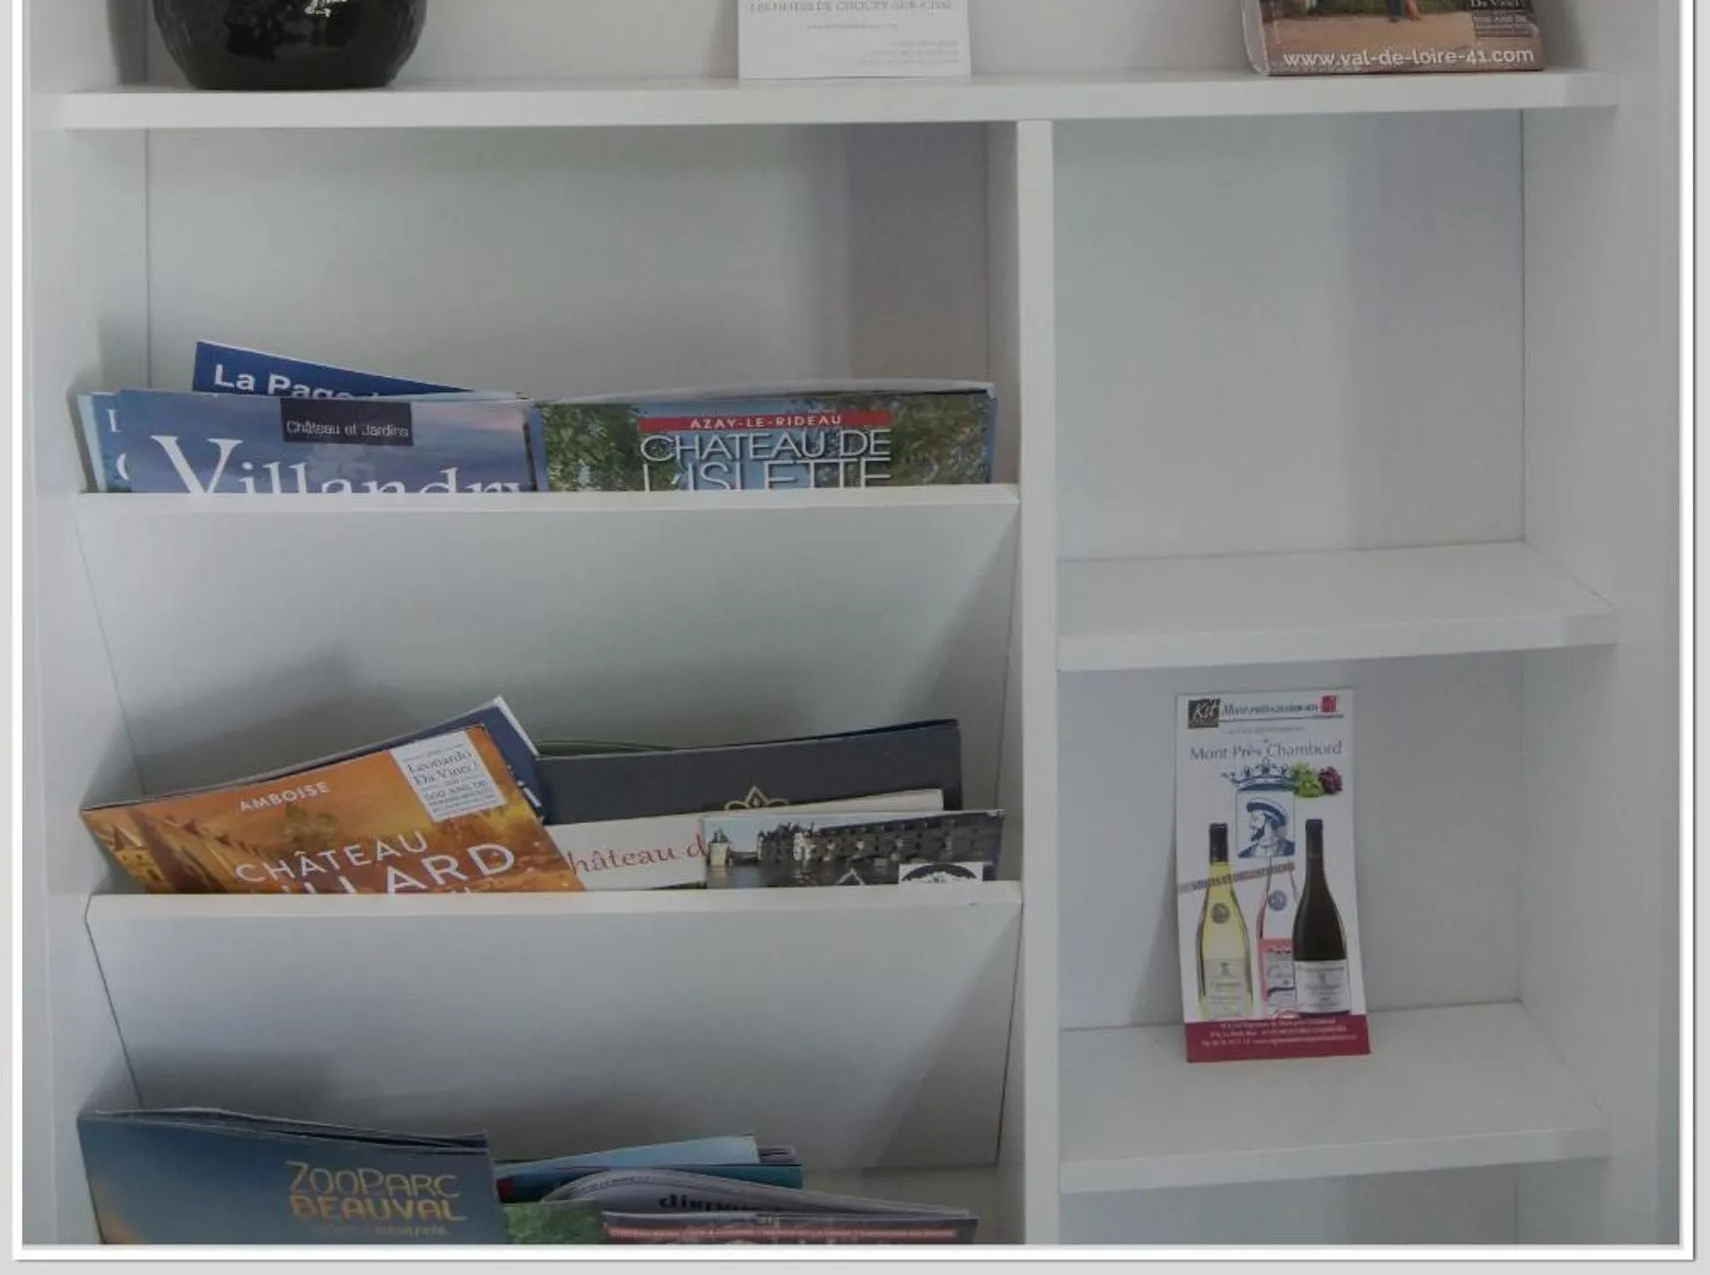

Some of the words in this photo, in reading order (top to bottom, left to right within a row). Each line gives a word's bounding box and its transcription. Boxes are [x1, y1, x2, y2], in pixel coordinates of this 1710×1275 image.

[1282, 46, 1536, 67] www.val-de-loire-41.com
[213, 363, 256, 392] La
[689, 414, 842, 430] AZAY-LE-RIDEAU
[639, 430, 826, 462] CHATEAU
[838, 429, 893, 459] DE
[1189, 746, 1228, 762] Mont
[1266, 740, 1343, 758] Chambord
[238, 780, 331, 813] AMBOISE
[234, 829, 429, 883] CHÂTEAU
[567, 846, 676, 875] hâteau
[288, 1194, 468, 1223] BEAUVAL
